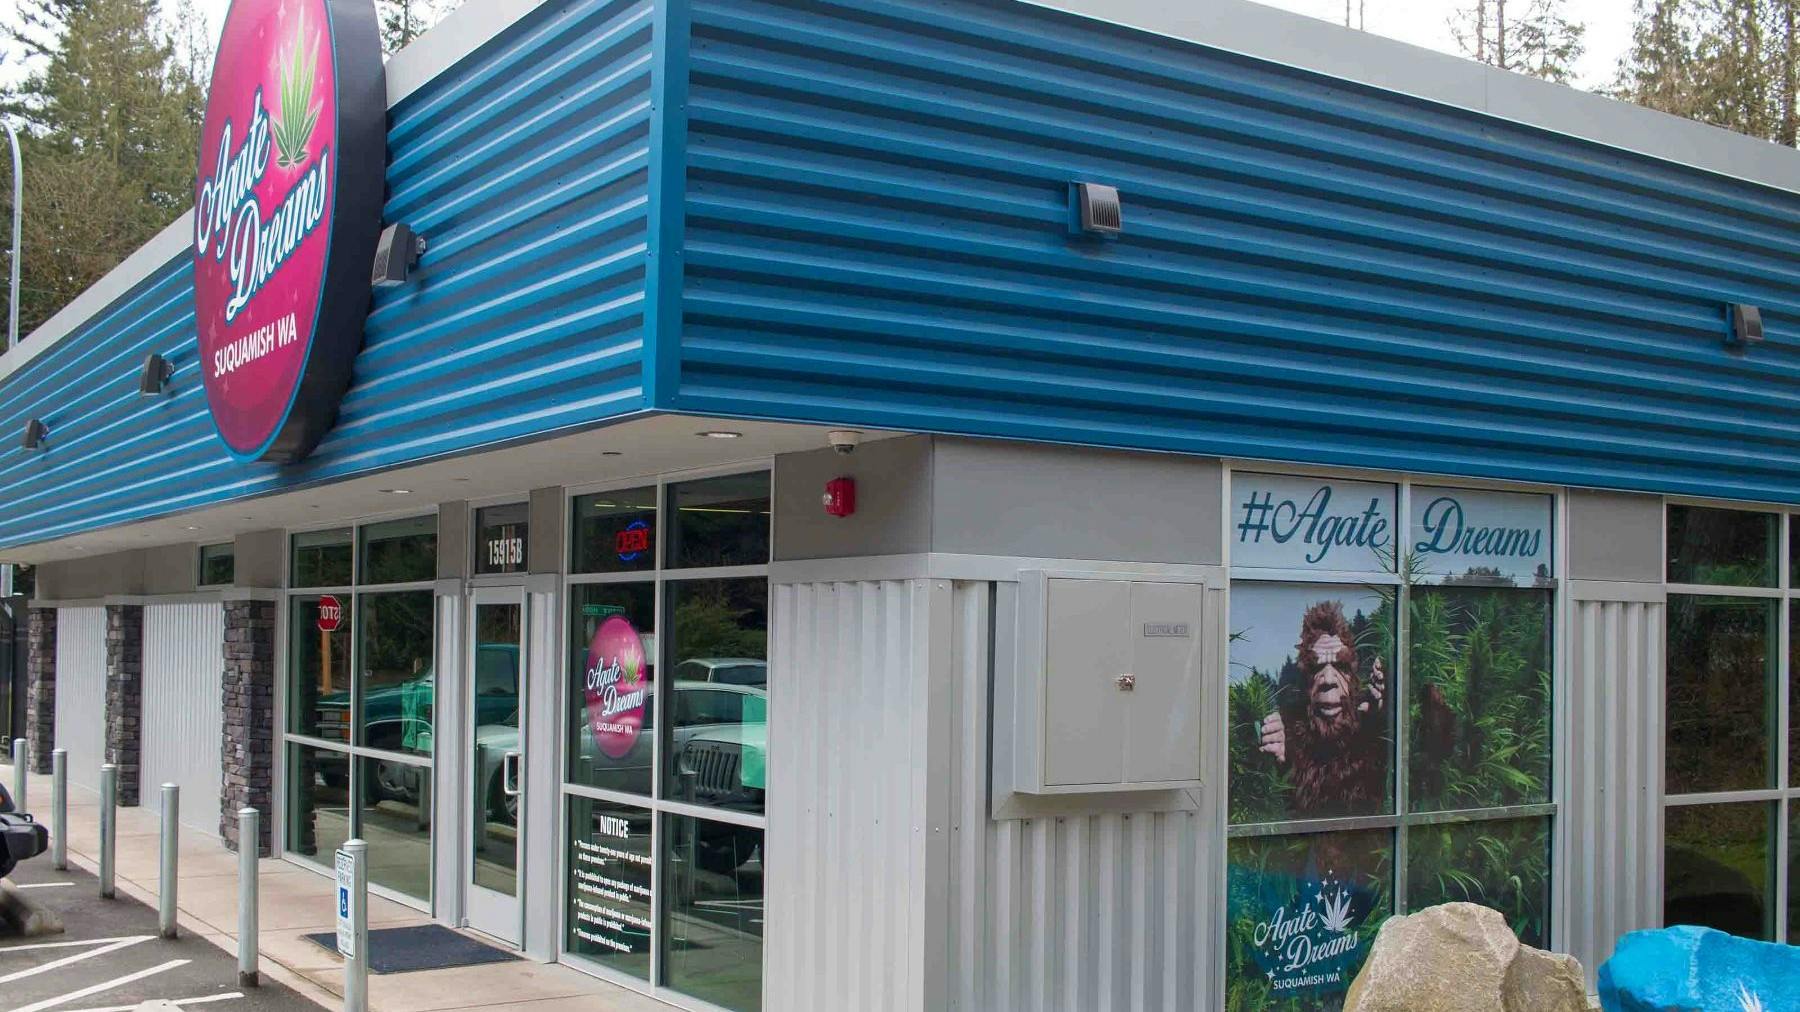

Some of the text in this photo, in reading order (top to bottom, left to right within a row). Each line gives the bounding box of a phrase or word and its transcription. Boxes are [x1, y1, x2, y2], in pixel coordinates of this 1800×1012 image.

[197, 93, 271, 259] Agate
[226, 152, 329, 321] Dreams
[214, 312, 297, 378] SUQUAMISH WA
[615, 527, 649, 553] OPEN
[1238, 485, 1542, 564] #Agate Dreams
[488, 537, 523, 566] 15915B
[587, 656, 621, 696] Agate
[602, 685, 644, 717] Dreams
[596, 721, 624, 734] SUQUAMISH
[600, 815, 629, 839] NOTICE
[1254, 902, 1318, 950] Agate
[1284, 931, 1359, 972] Dreams
[1273, 972, 1341, 990] SUQUAMISH WA
